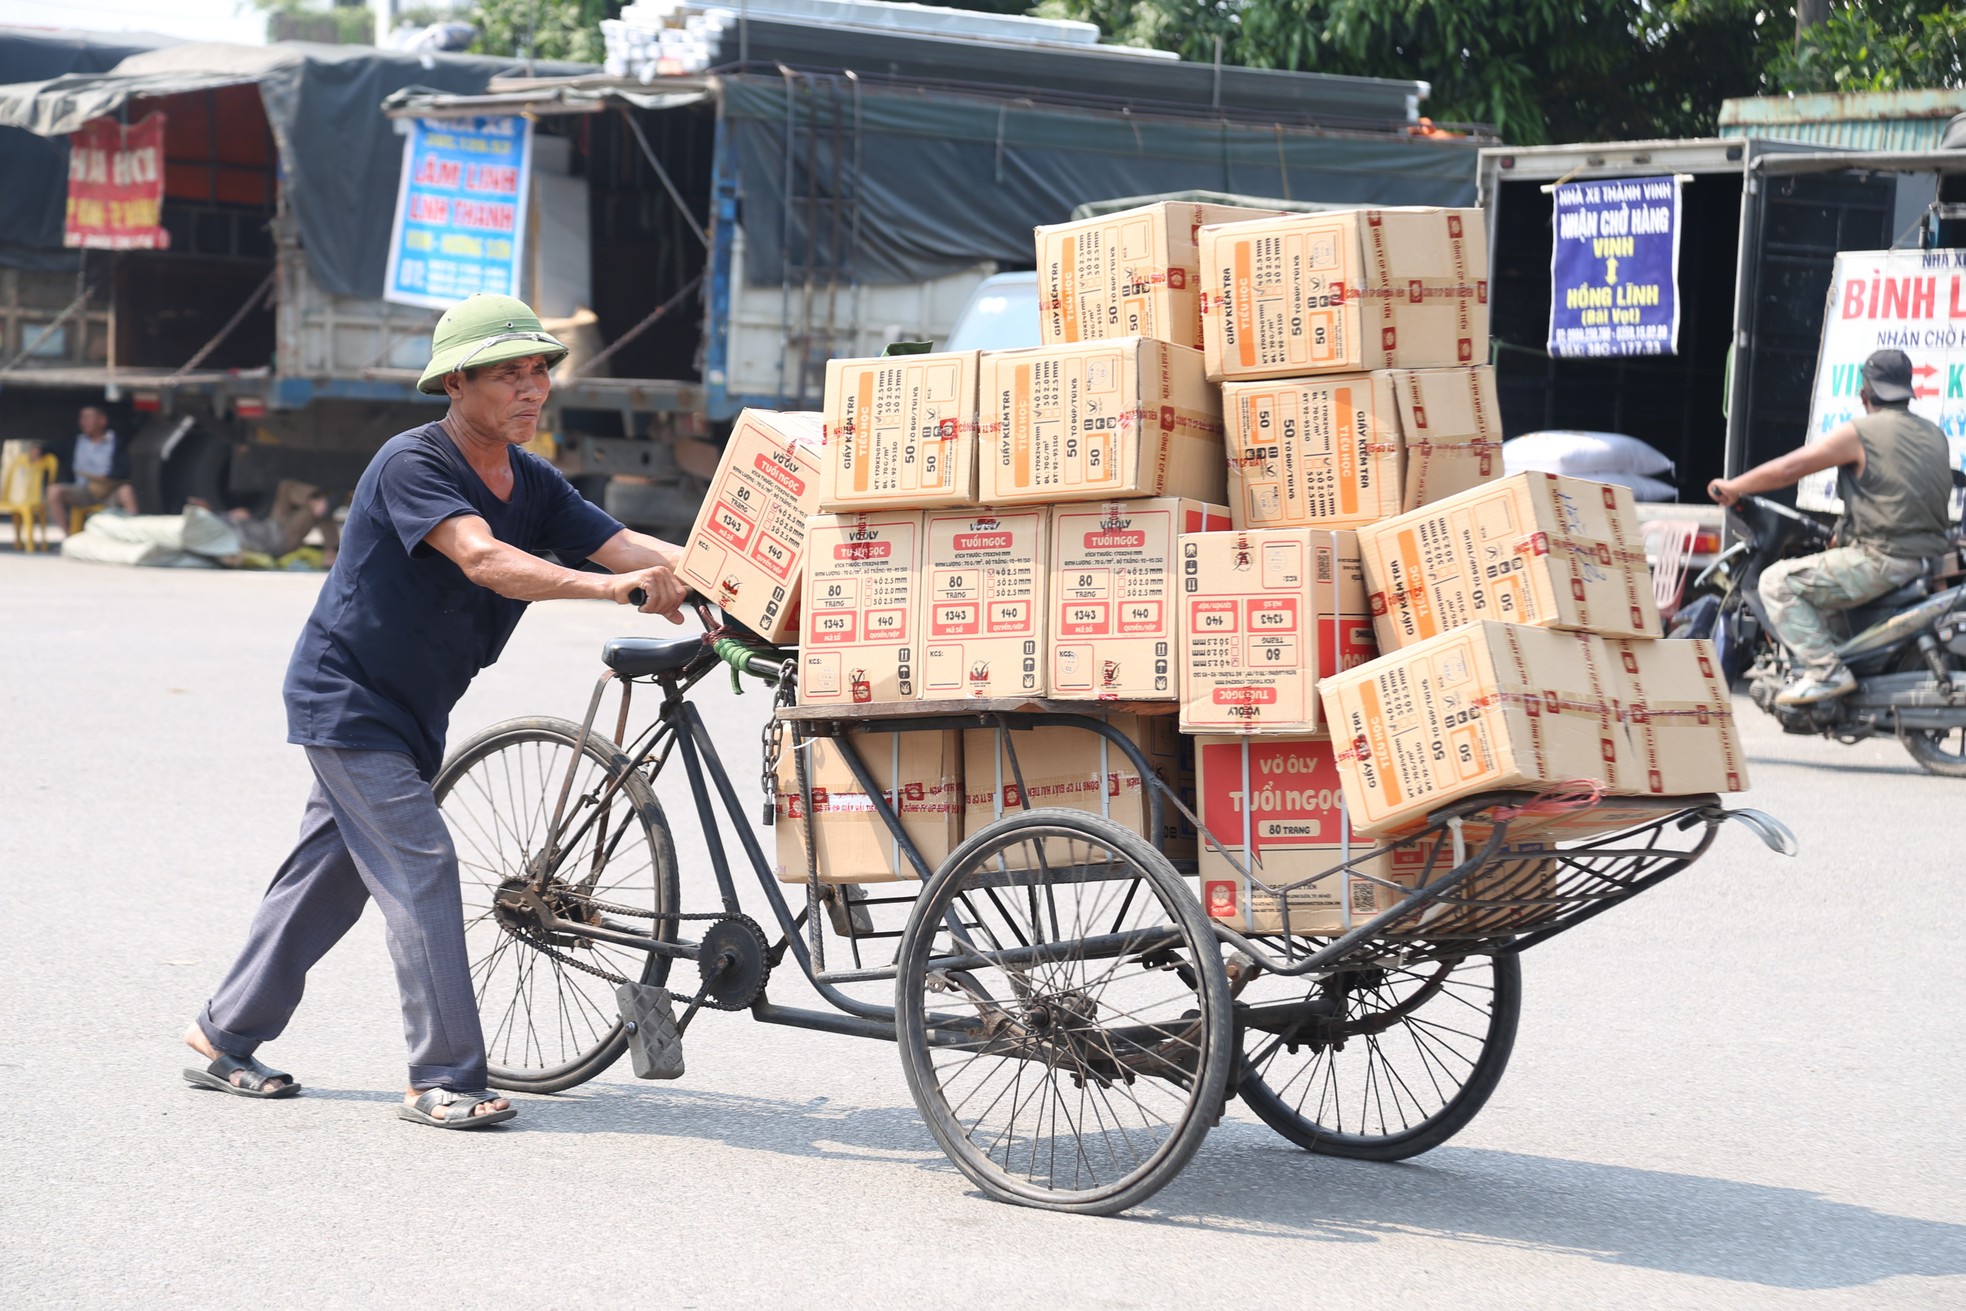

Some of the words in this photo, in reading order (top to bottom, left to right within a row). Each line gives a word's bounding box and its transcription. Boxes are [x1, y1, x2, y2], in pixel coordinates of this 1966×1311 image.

[1559, 185, 1584, 206] NHÀ
[1586, 188, 1600, 204] XE
[1602, 181, 1642, 203] THÀNH
[1643, 182, 1671, 201] VINH
[1560, 207, 1598, 243] NHẬN
[1600, 202, 1629, 236] CHỞ
[1631, 204, 1669, 234] HÀNG
[1593, 236, 1634, 258] VINH
[1223, 268, 1231, 288] TRA
[1239, 277, 1250, 301] HỌC
[1567, 282, 1612, 309] HỒNG
[1617, 282, 1659, 306] LĨNH
[1842, 268, 1936, 320] BÌNH
[1221, 290, 1233, 317] KIỂM
[1053, 311, 1061, 336] GIẤY
[1108, 306, 1118, 324] 50
[1129, 314, 1138, 331] 50
[1239, 303, 1250, 329] TIỂU
[1225, 319, 1235, 345] GIẤY
[1291, 317, 1302, 336] 50
[1315, 327, 1325, 344] 50
[1035, 363, 1041, 380] mm
[847, 396, 855, 415] TRA
[1018, 400, 1028, 424] HỌC
[861, 406, 870, 429] HỌC
[1001, 412, 1010, 439] KIỂM
[1259, 411, 1270, 428] 50
[1357, 411, 1367, 437] GIẤY
[1017, 425, 1027, 451] TIỂU
[1035, 426, 1040, 441] mm
[1284, 419, 1295, 438] 50
[856, 430, 868, 456] TIỂU
[1066, 439, 1077, 457] 50
[1340, 425, 1352, 452] TIỂU
[843, 444, 852, 469] GIẤY
[905, 445, 915, 463] 50
[1000, 440, 1010, 466] GIẤY
[1090, 449, 1100, 466] 50
[926, 456, 936, 472] 50
[1341, 454, 1351, 477] HỌC
[1360, 468, 1369, 488] TRA
[737, 486, 750, 501] 80
[723, 514, 741, 532] 1343
[768, 545, 782, 560] 140
[1391, 560, 1401, 581] TRA
[949, 576, 963, 587] 80
[1079, 575, 1092, 586] 80
[828, 585, 841, 597] 80
[1472, 590, 1486, 609] 50
[1501, 594, 1513, 611] 50
[878, 616, 893, 626] 140
[945, 611, 966, 620] 1343
[1001, 608, 1017, 618] 140
[1074, 610, 1096, 620] 1343
[1132, 609, 1148, 618] 140
[1206, 616, 1223, 626] 140
[1261, 614, 1283, 624] 1343
[824, 619, 844, 628] 1343
[1400, 611, 1414, 635] GIẤY
[1266, 648, 1281, 661] 80
[1352, 712, 1362, 733] TRA
[1370, 716, 1385, 741] HỌC
[1374, 741, 1390, 769] TIỂU
[1432, 740, 1445, 760] 50
[1459, 744, 1471, 762] 50
[1259, 754, 1284, 774] VỞ
[1287, 754, 1318, 773] ÔLY
[1363, 763, 1376, 788] GIẤY
[1052, 784, 1065, 796] GIẤY
[1066, 783, 1074, 793] CP
[1075, 782, 1082, 792] TY
[1082, 781, 1099, 792] CÔNG
[1269, 824, 1282, 835] 80
[1283, 826, 1310, 835] TRANG
